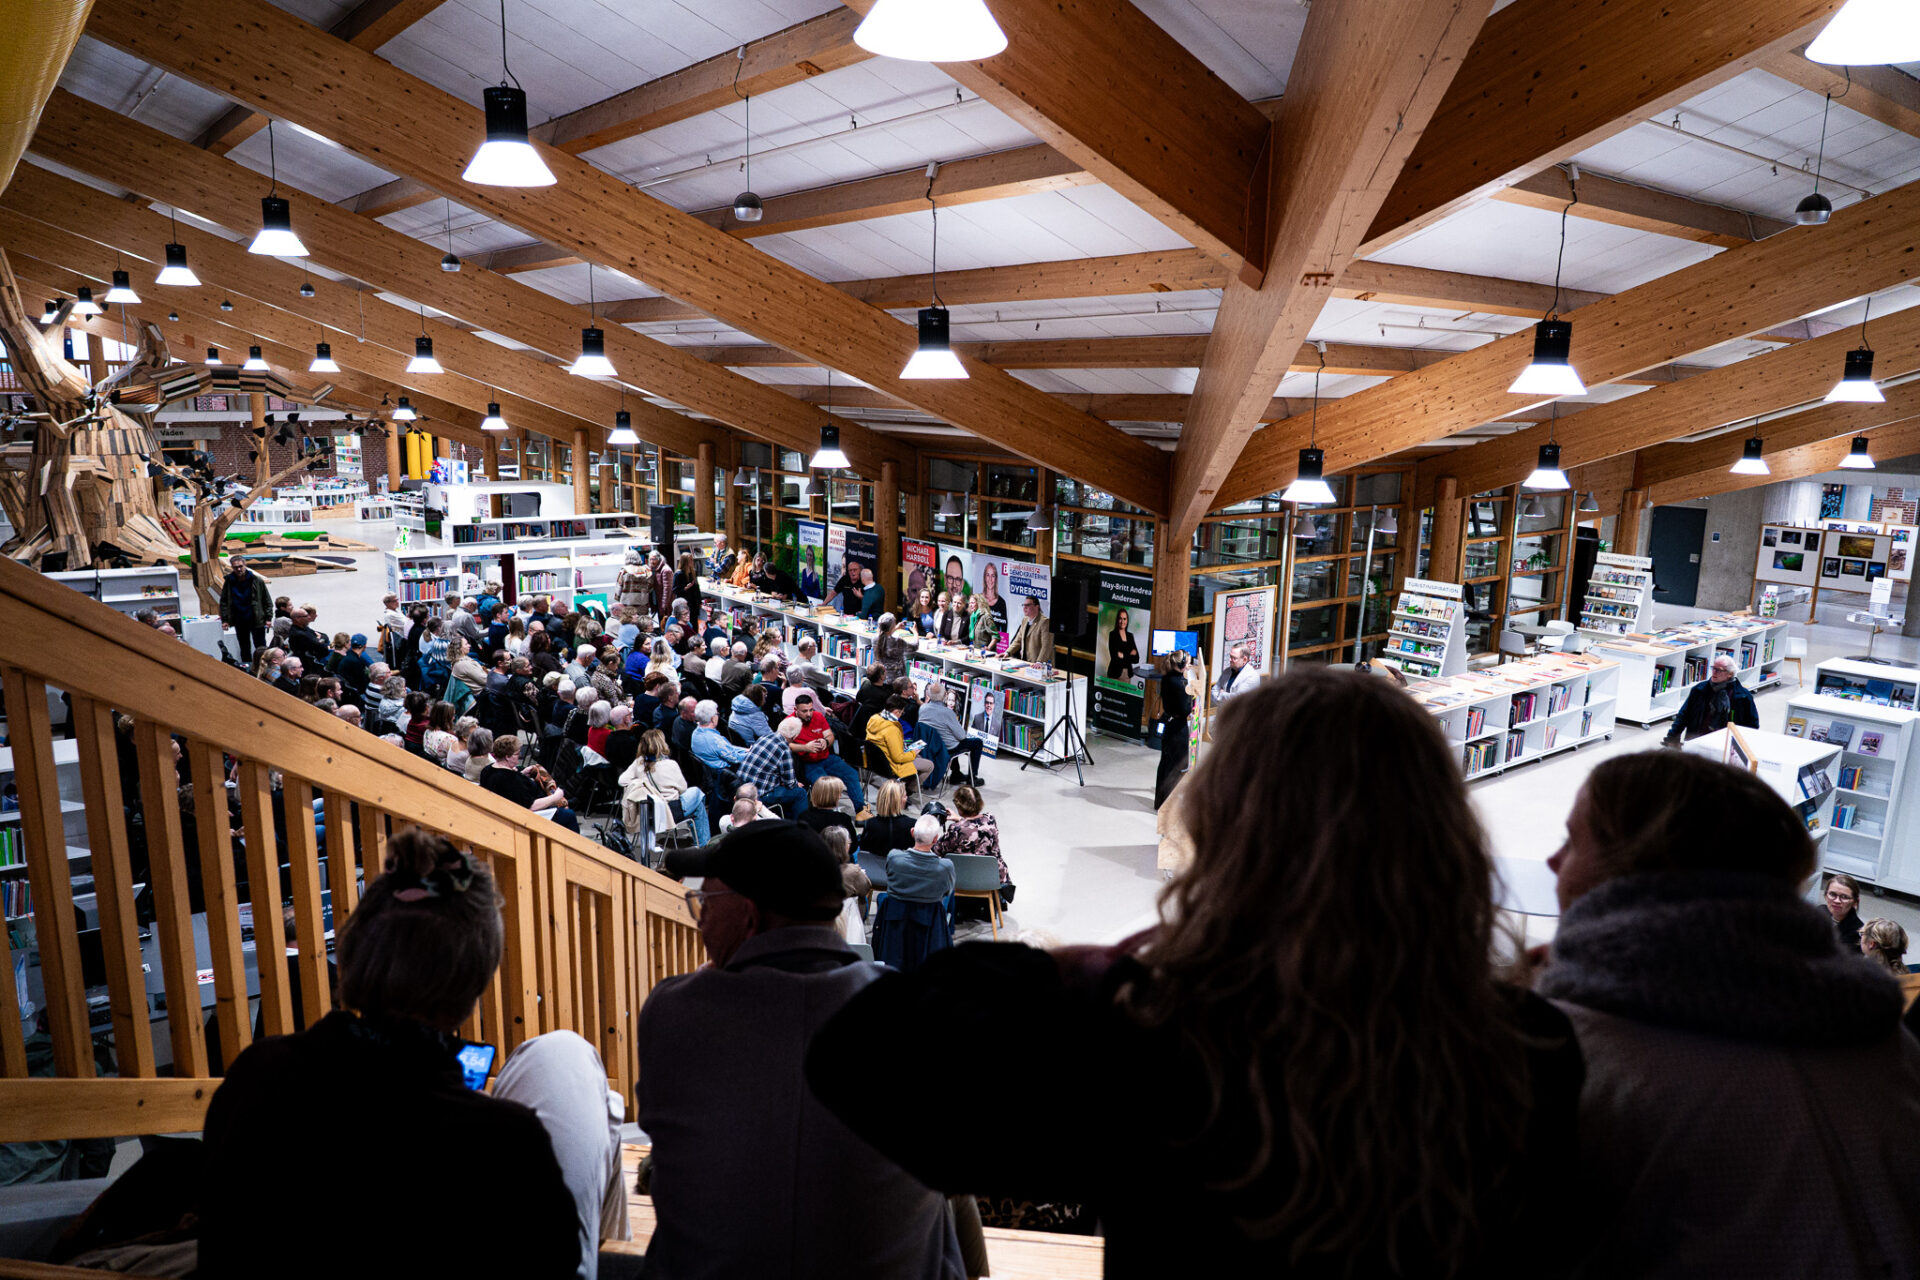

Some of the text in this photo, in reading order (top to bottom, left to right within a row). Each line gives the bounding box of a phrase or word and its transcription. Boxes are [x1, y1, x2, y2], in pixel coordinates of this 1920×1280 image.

[907, 545, 930, 556] MICHAEL
[1010, 584, 1047, 598] DYREBORG
[1101, 581, 1152, 596] May-Britt Andrea
[1112, 593, 1140, 604] Andersen
